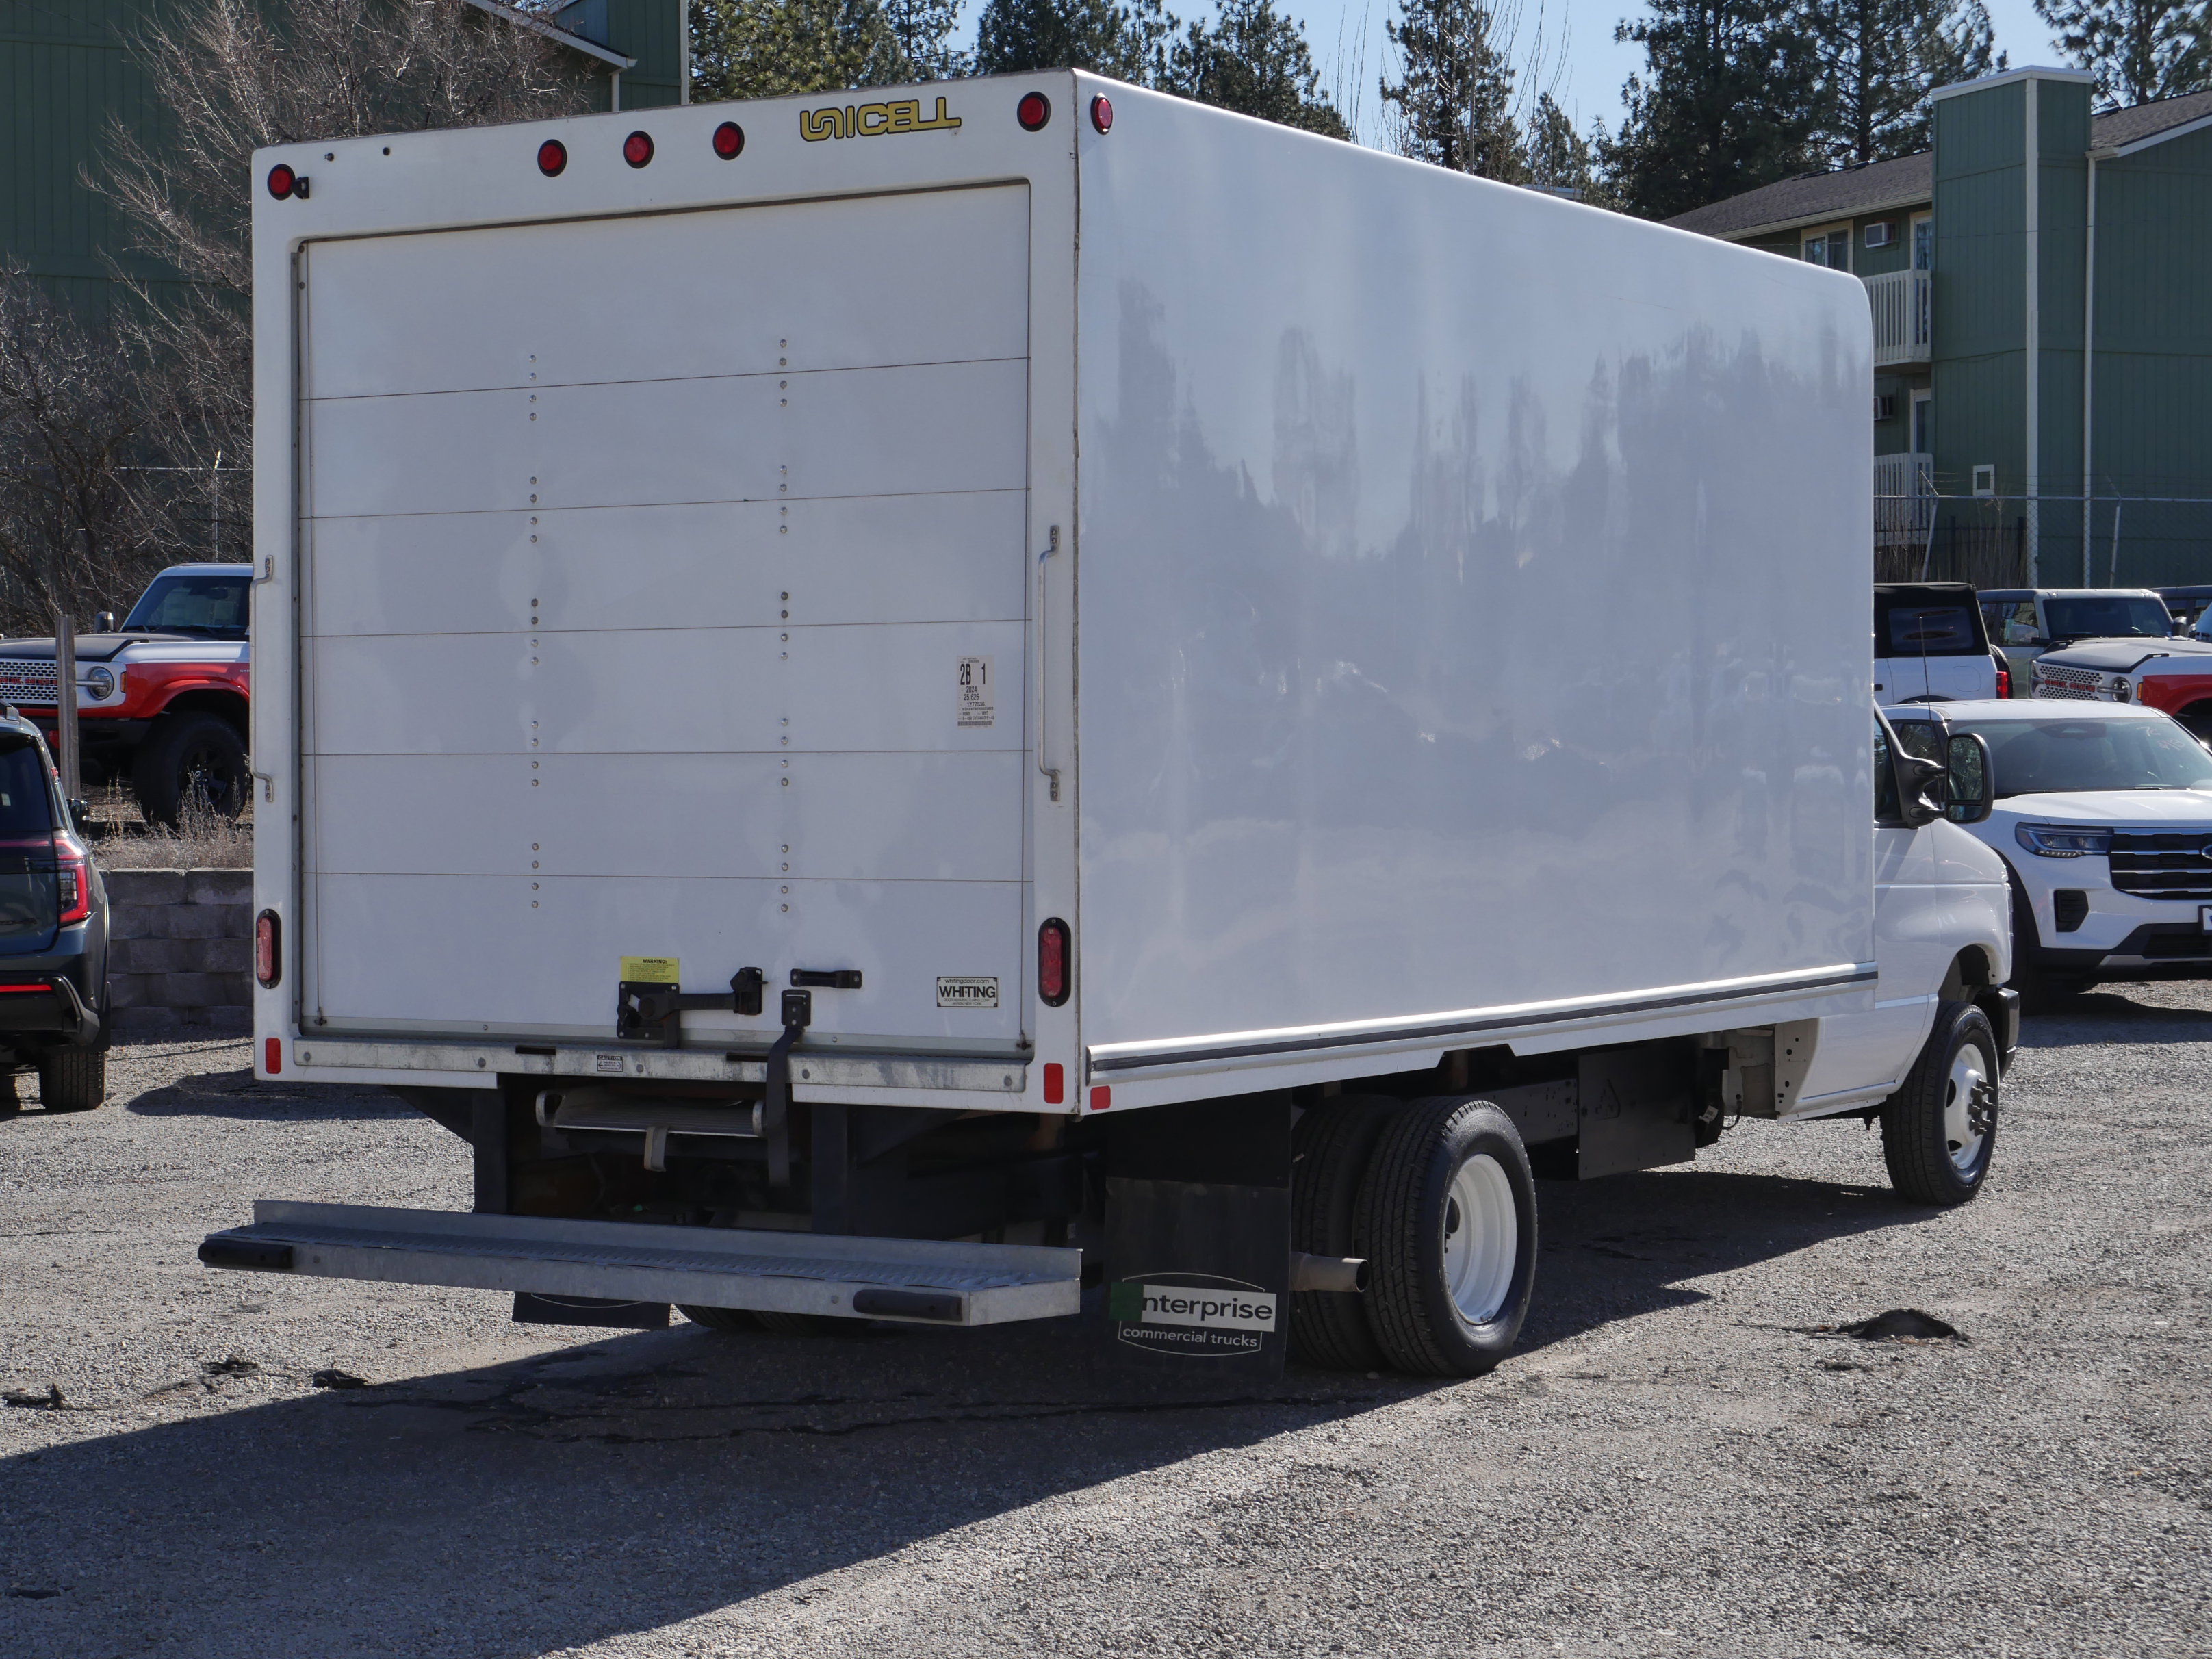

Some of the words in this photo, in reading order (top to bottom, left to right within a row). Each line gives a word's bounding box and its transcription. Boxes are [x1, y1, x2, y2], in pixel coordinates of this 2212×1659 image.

[799, 97, 962, 142] UNICELL
[960, 663, 971, 685] 2B
[981, 663, 986, 685] 1
[939, 986, 996, 998] WHITING
[1122, 1328, 1207, 1343] commercial
[1210, 1334, 1257, 1347] trucks
